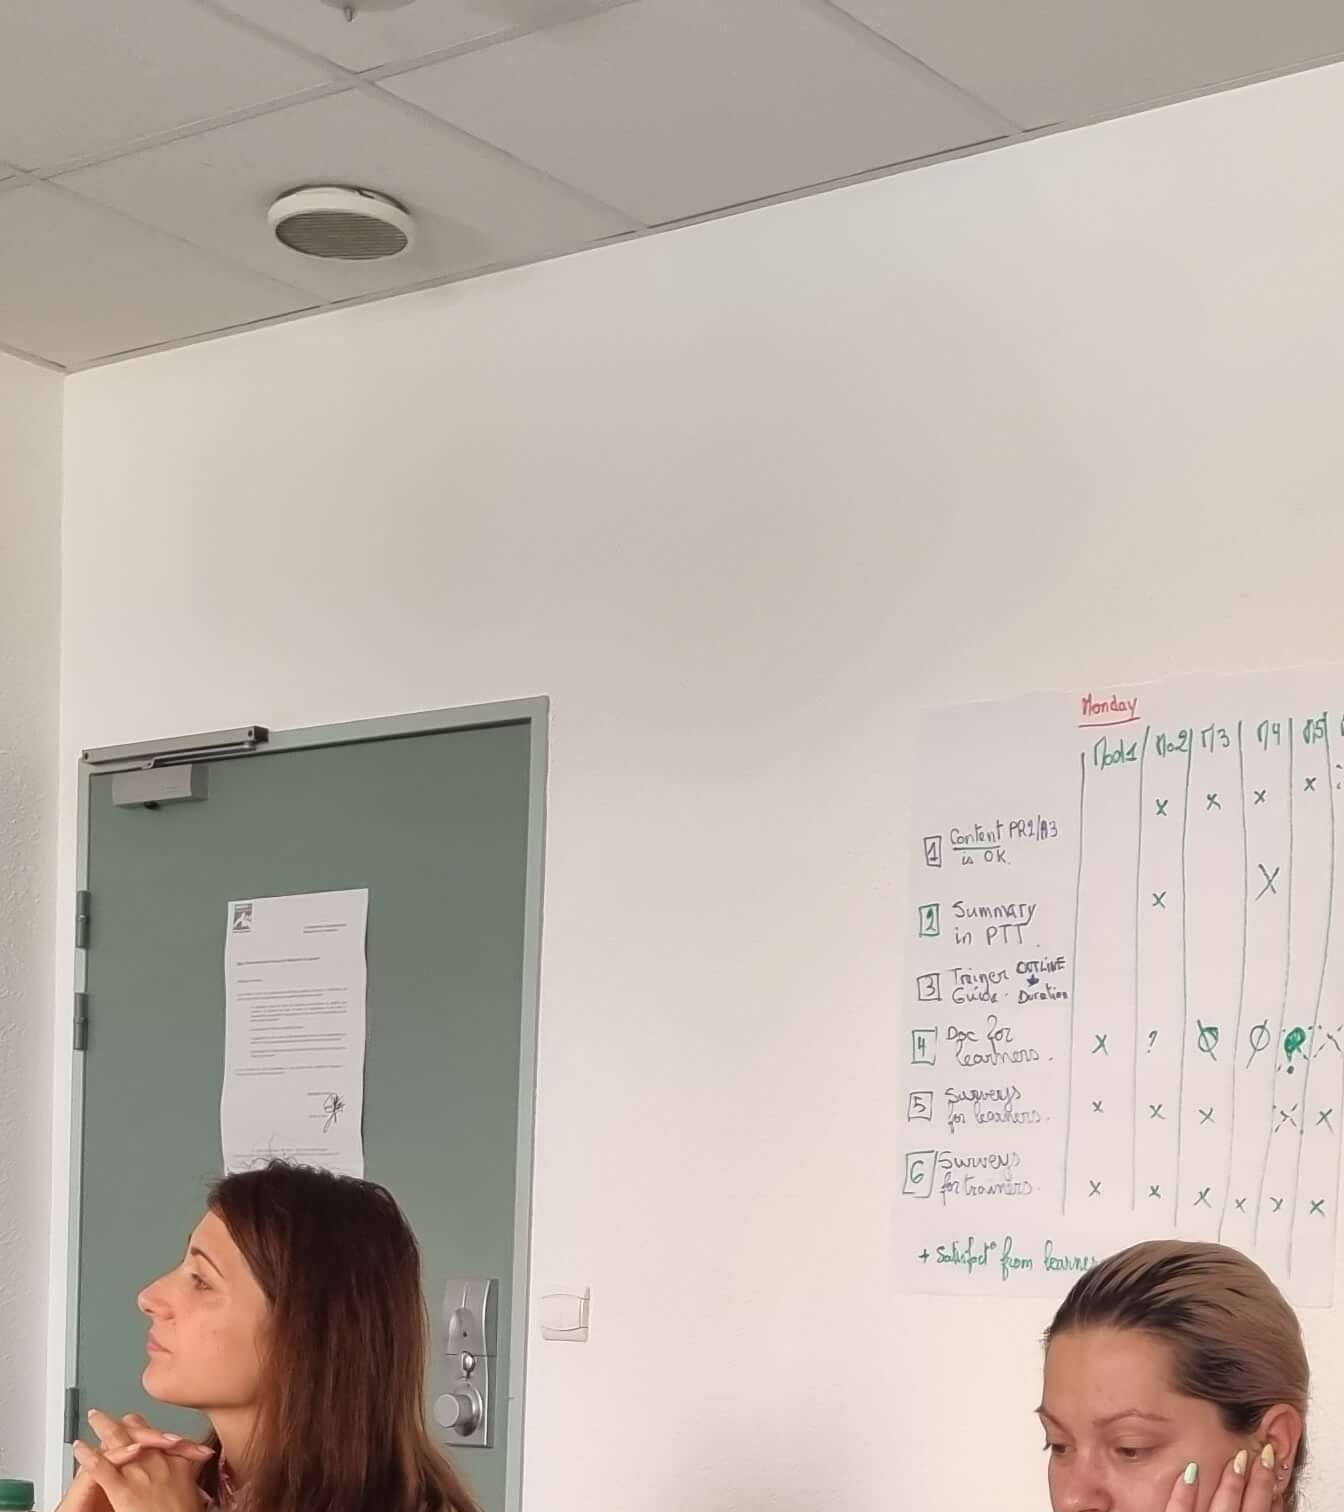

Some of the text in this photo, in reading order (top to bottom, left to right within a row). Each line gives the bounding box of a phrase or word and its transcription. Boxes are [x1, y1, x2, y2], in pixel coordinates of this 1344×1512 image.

[1082, 693, 1138, 717] Monday
[950, 820, 1003, 844] Content
[952, 901, 1036, 925] Summary
[955, 927, 972, 944] in
[1000, 1236, 1033, 1281] from
